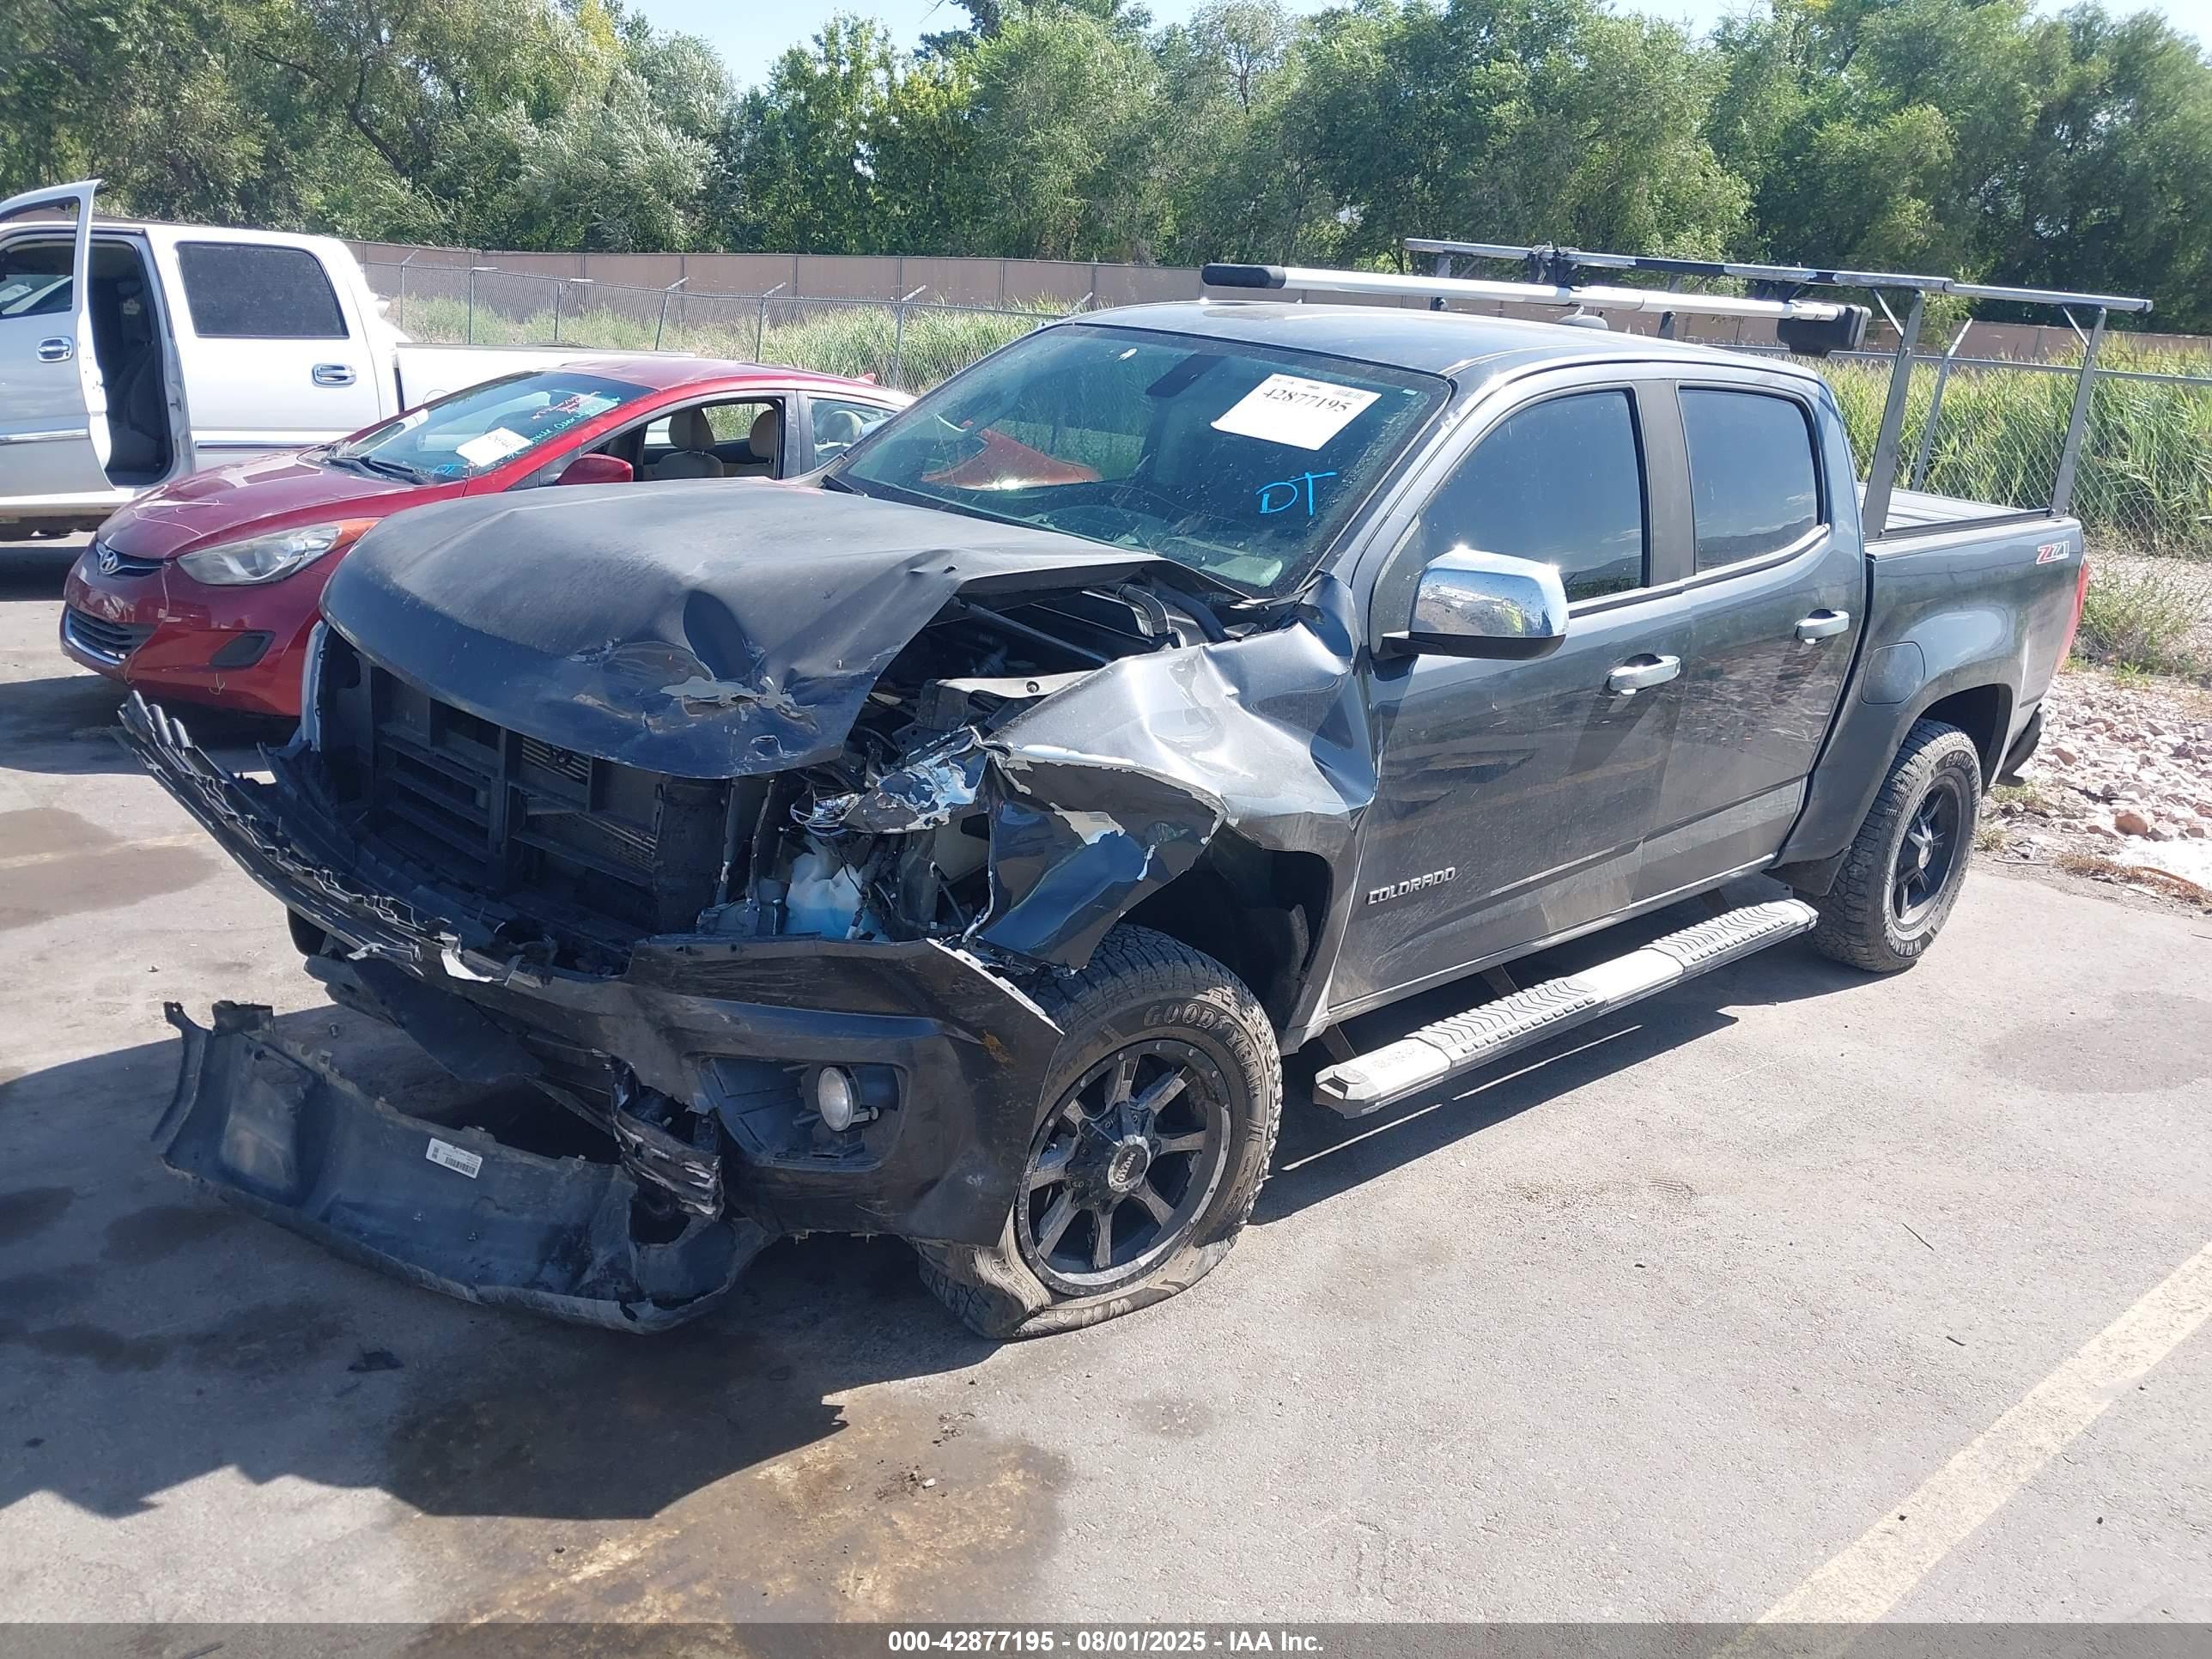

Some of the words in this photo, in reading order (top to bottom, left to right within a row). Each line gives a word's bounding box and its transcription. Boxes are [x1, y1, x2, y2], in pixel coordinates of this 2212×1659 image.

[1263, 388, 1353, 412] 42877195
[1255, 471, 1338, 516] DT
[2036, 540, 2069, 565] Z71
[1367, 866, 1456, 905] COLORADO
[1143, 1003, 1264, 1099] GOODYEAR
